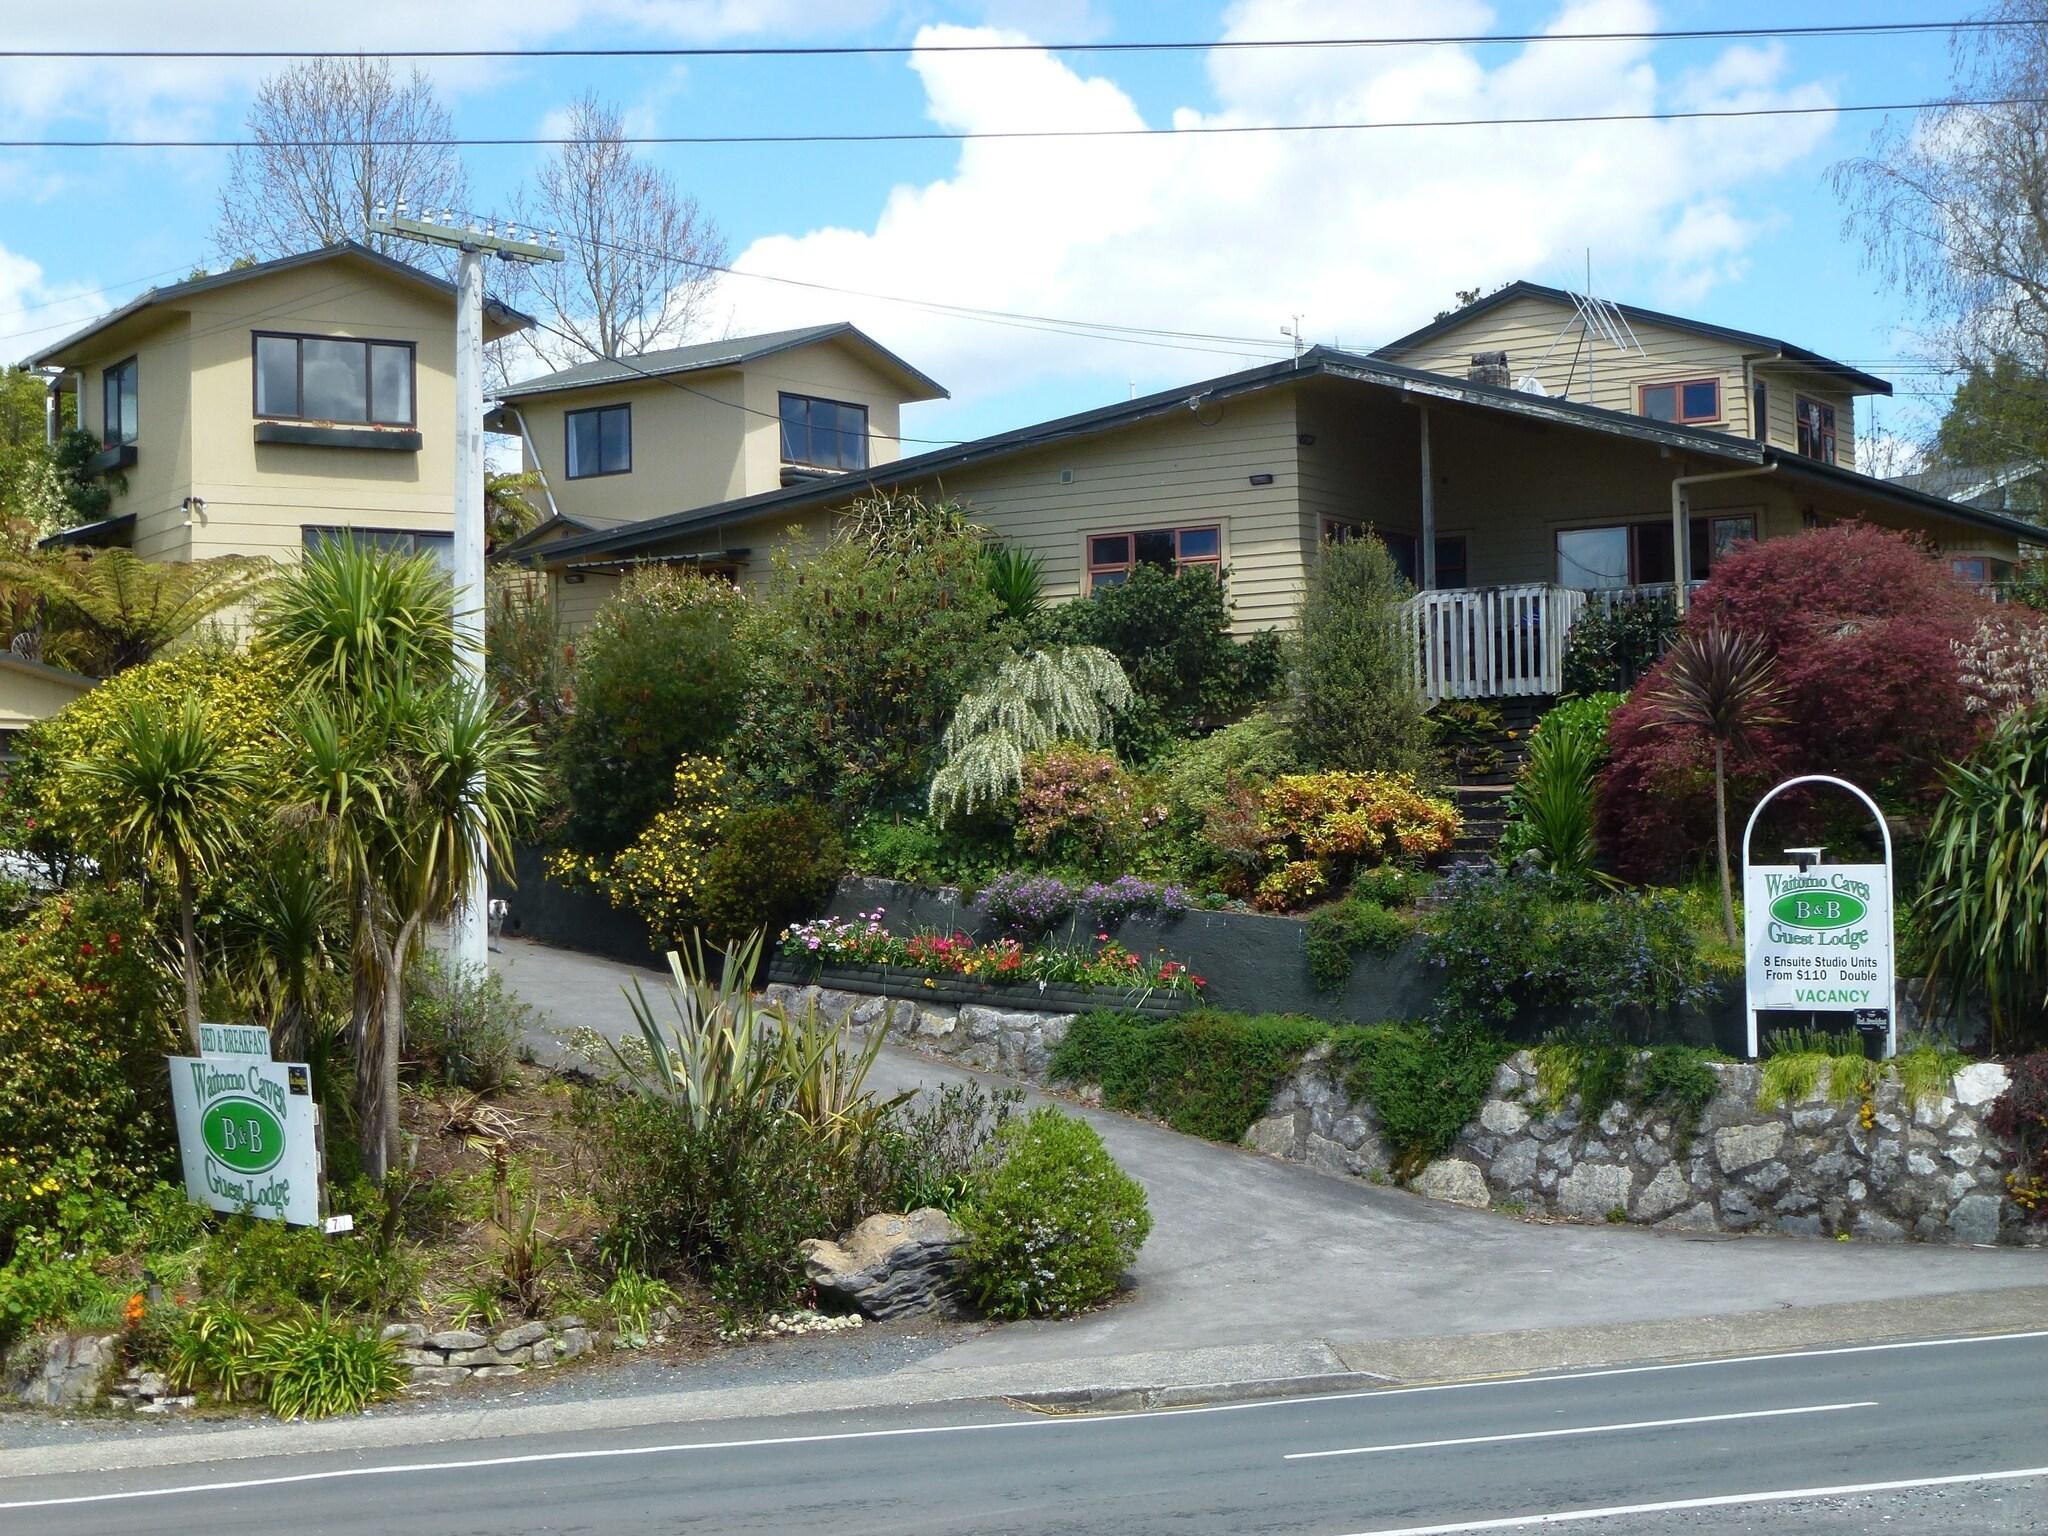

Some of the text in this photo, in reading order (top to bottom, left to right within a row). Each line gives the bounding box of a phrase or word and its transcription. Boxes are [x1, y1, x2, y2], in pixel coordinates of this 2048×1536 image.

[1764, 873, 1870, 901] Waitomo Caves
[1768, 922, 1869, 950] Guest Lodge
[1764, 956, 1878, 968] 8 Ensuite Studio Units
[1766, 969, 1877, 981] From $110 Double
[1795, 989, 1870, 1002] VACANCY
[200, 1028, 215, 1052] BED
[223, 1030, 268, 1055] BREAKFAST
[190, 1063, 245, 1110] Waitomo
[248, 1065, 287, 1119] Caves
[205, 1155, 290, 1216] Guest Lodge
